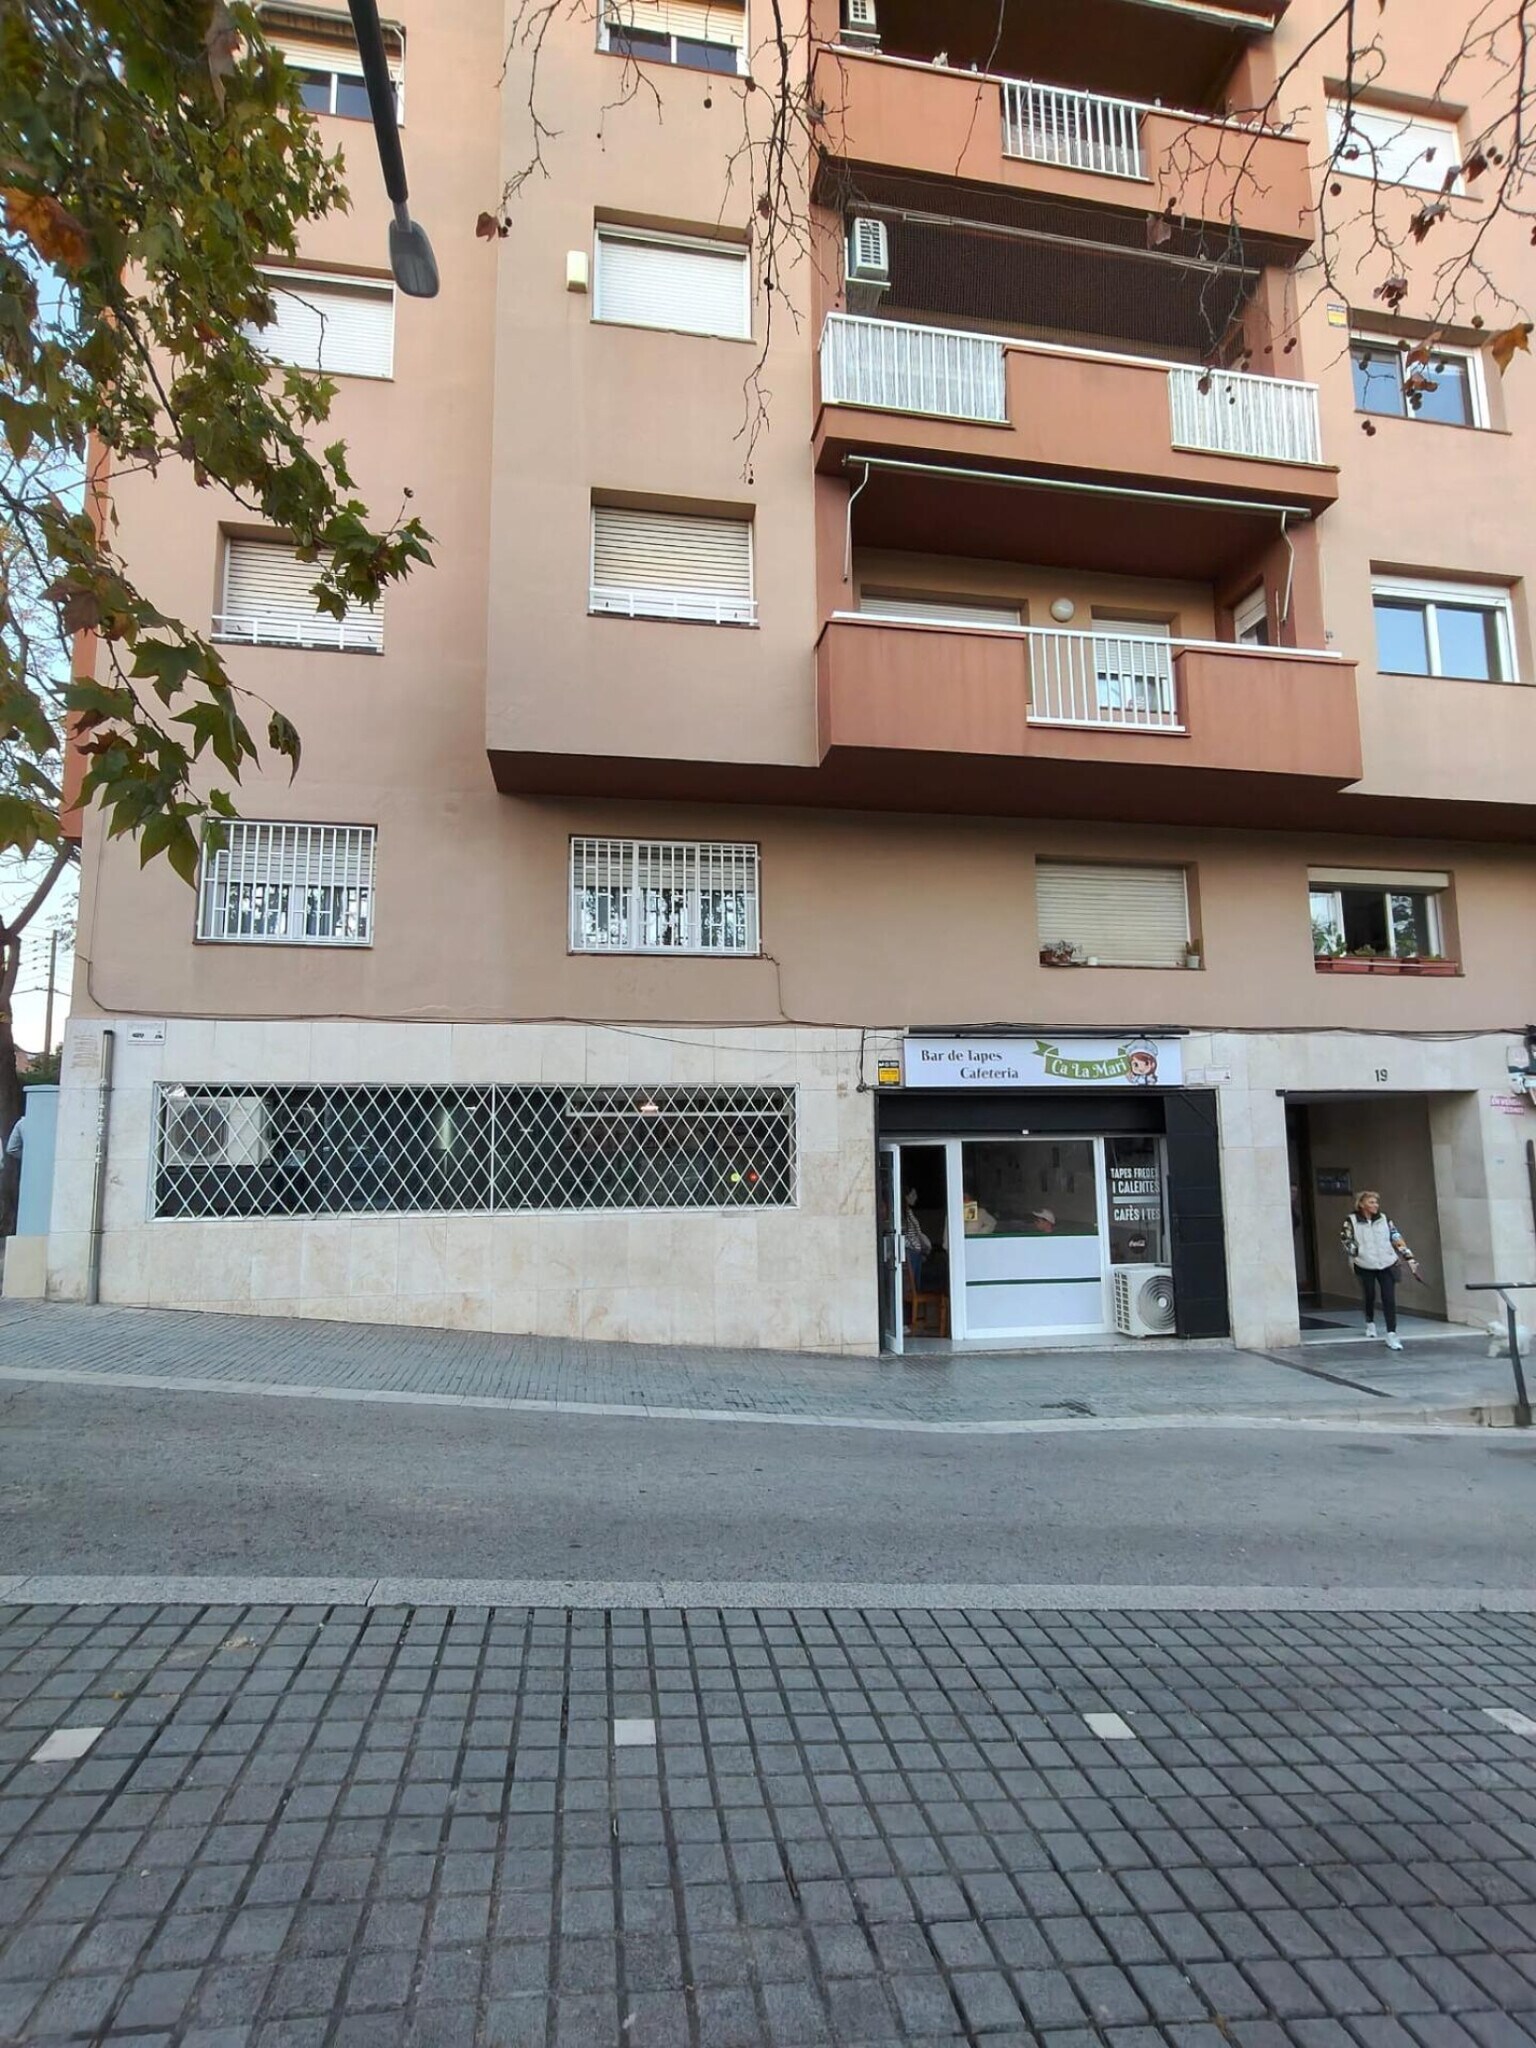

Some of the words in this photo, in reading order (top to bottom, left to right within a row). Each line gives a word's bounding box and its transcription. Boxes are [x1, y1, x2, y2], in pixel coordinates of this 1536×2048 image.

[921, 1049, 944, 1061] Bar
[947, 1049, 964, 1061] de
[967, 1049, 1003, 1064] Tapes
[960, 1066, 1019, 1079] Cafeteria
[1051, 1059, 1068, 1075] Ca
[1092, 1058, 1127, 1078] Mari
[1375, 1068, 1388, 1082] 19
[1110, 1167, 1132, 1179] TAPES
[1118, 1180, 1160, 1194] CALENTES
